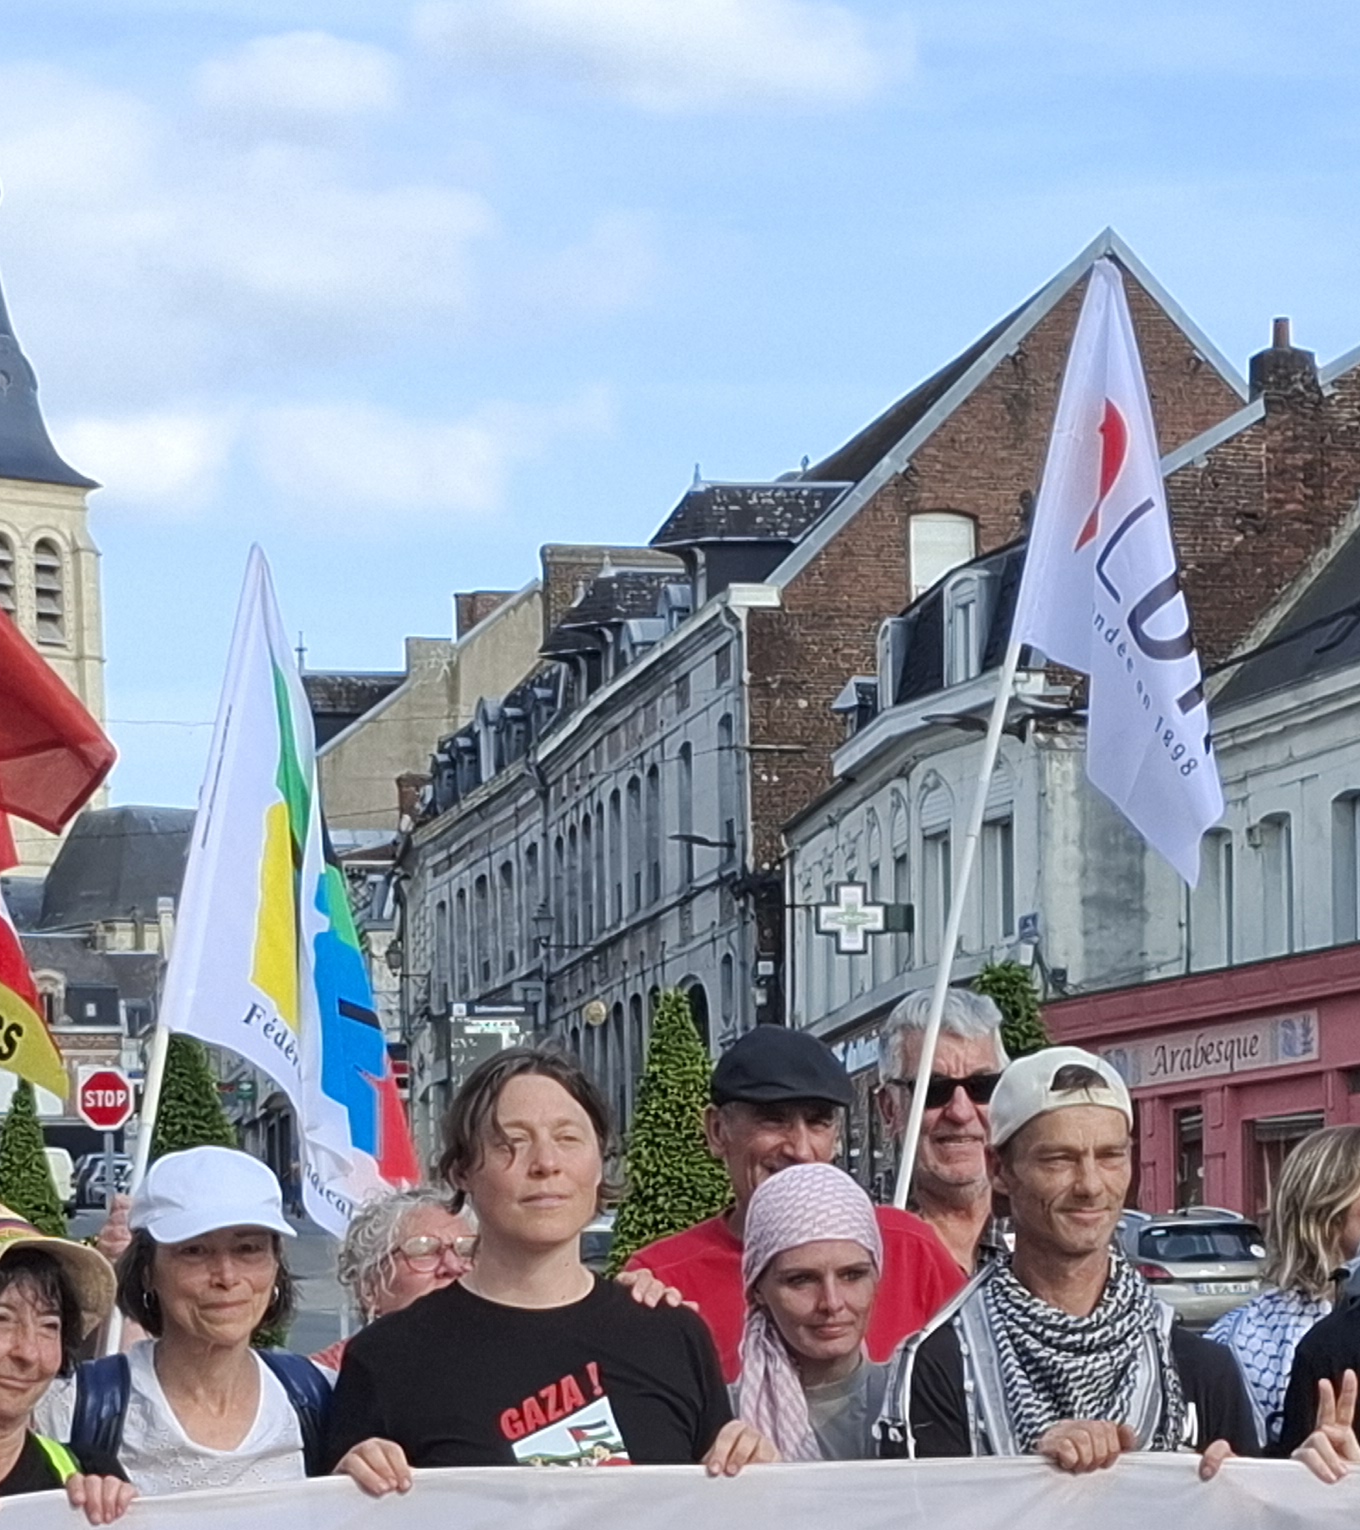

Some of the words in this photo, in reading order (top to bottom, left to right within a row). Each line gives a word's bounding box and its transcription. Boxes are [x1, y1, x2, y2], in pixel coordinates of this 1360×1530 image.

[1153, 715, 1199, 778] 1898
[1149, 1032, 1260, 1076] Arabesque
[84, 1089, 127, 1108] STOP
[500, 1374, 586, 1440] GAZA
